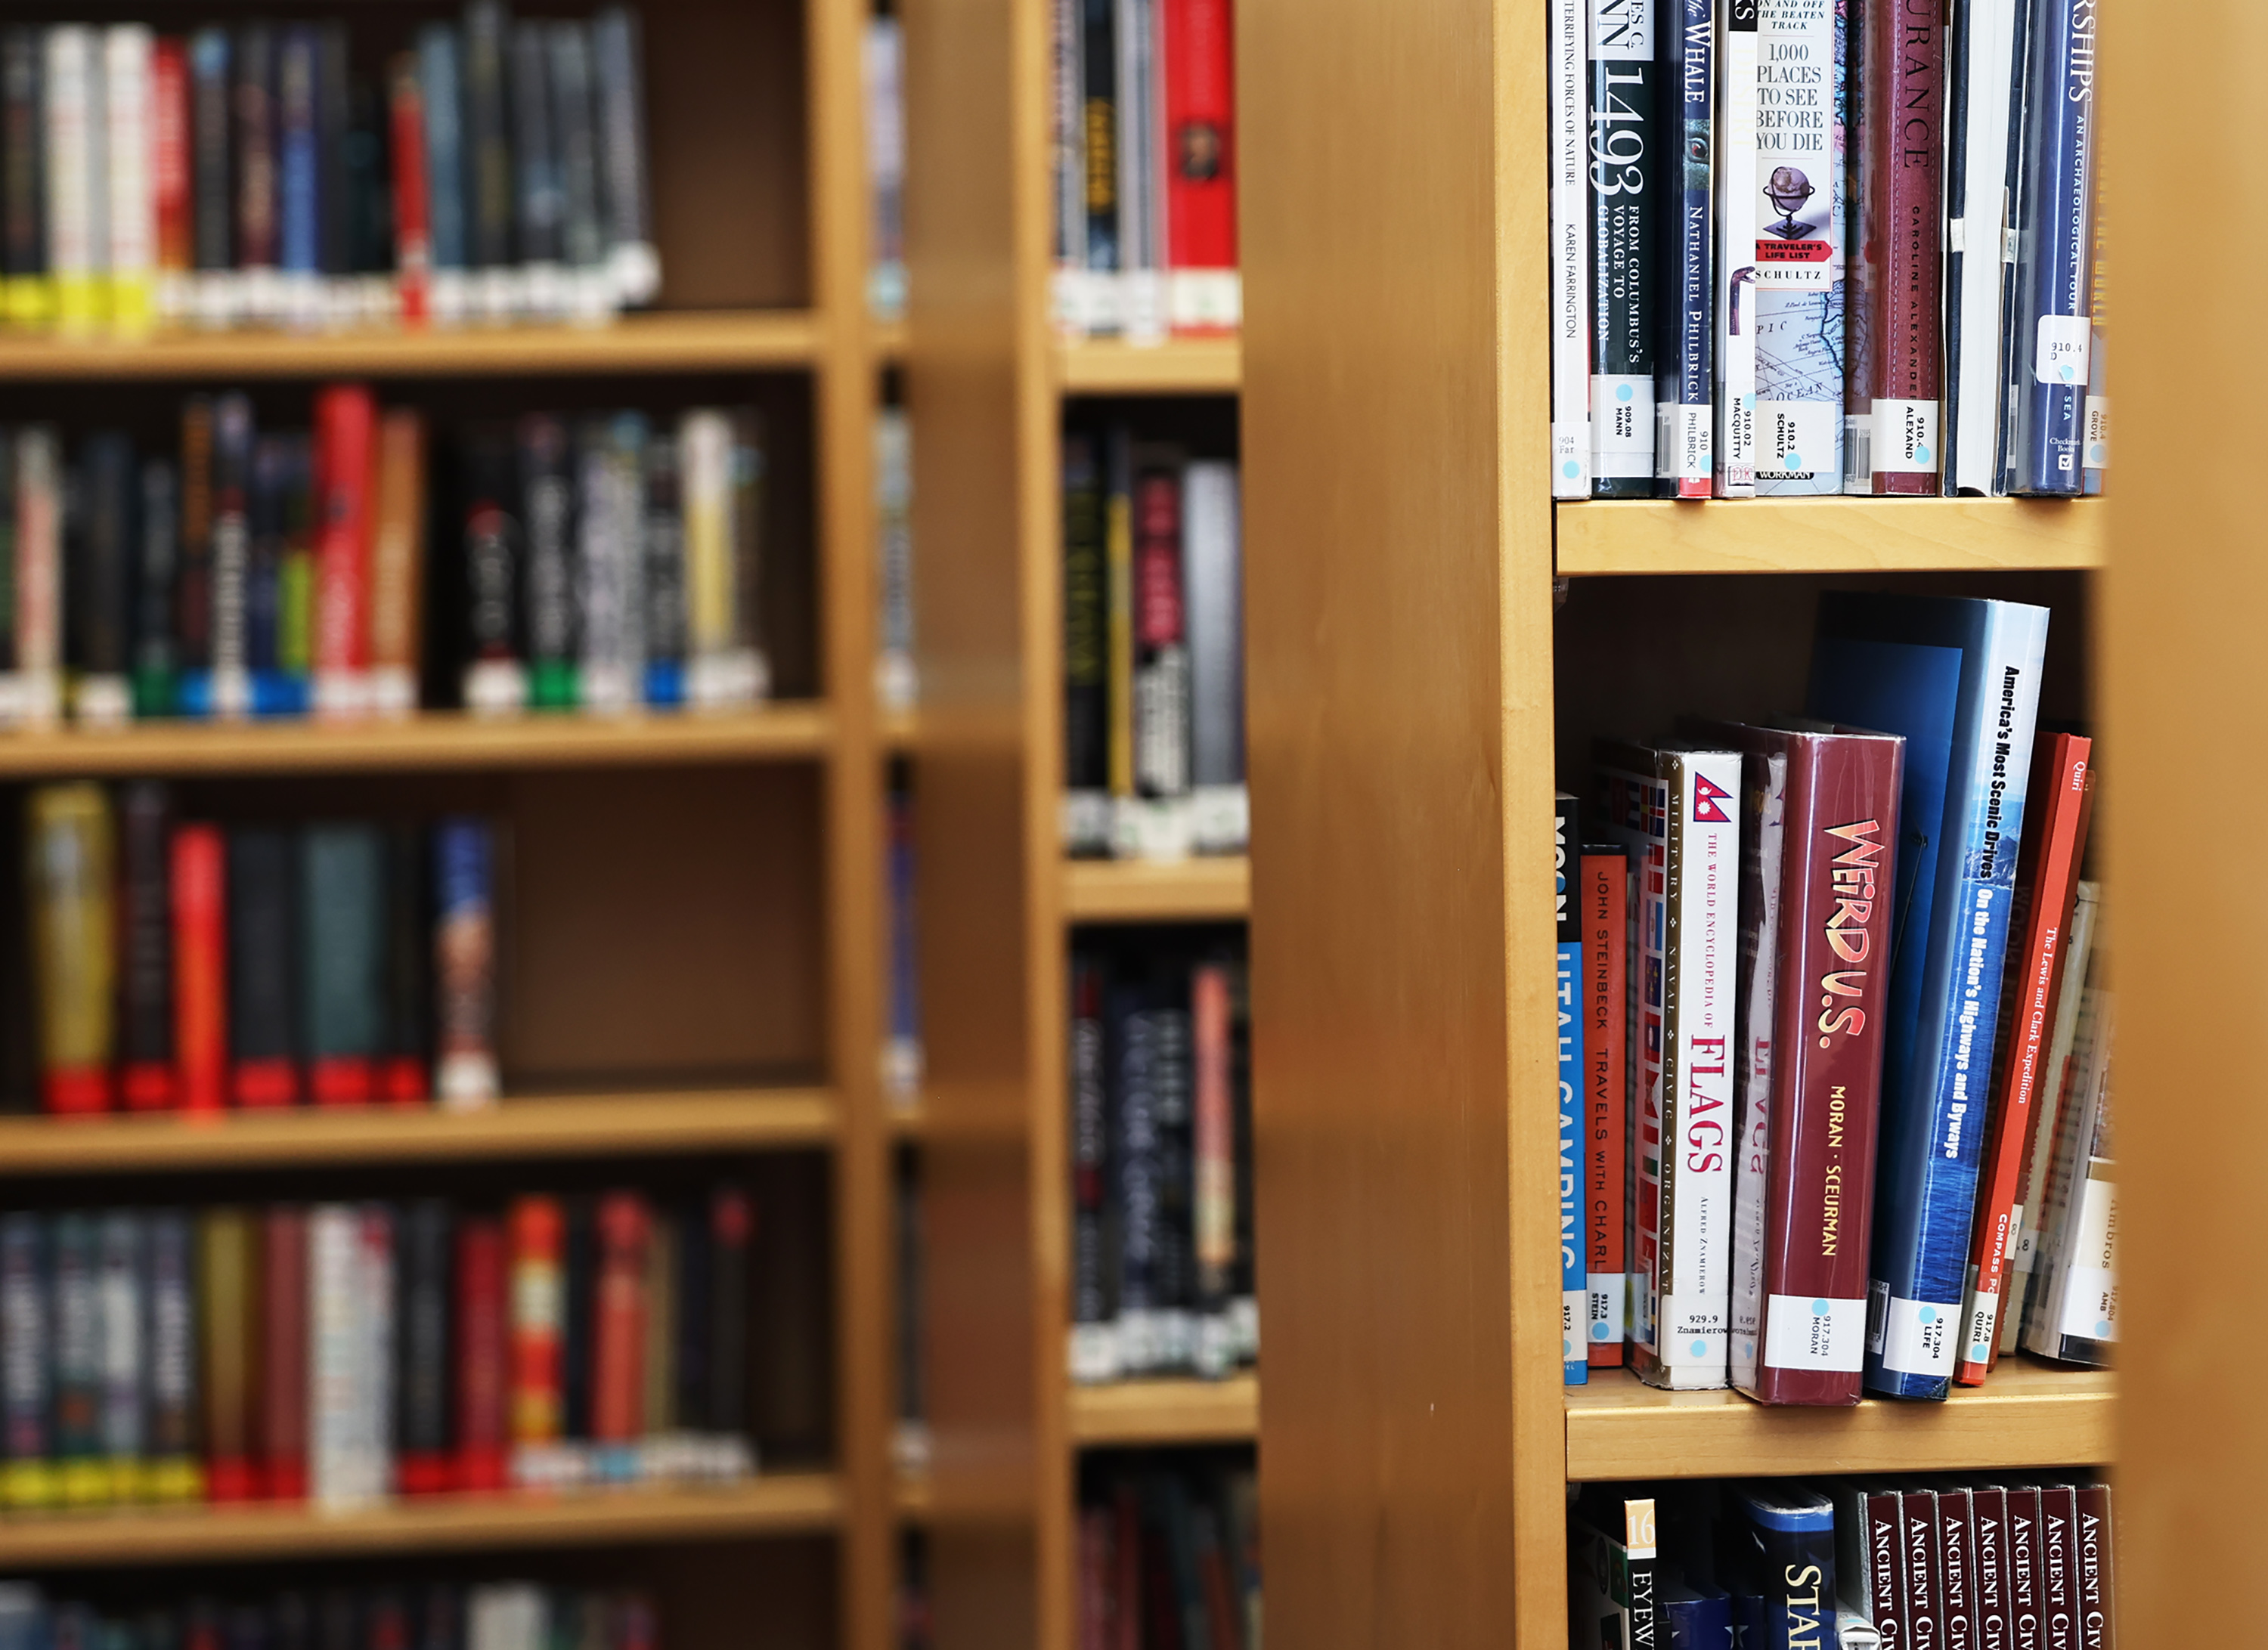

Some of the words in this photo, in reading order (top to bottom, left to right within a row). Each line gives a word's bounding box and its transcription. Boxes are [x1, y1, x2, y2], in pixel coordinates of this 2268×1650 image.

[1774, 0, 1799, 8] AND
[1802, 0, 1825, 9] OFF
[1781, 11, 1826, 20] BEATEN
[1563, 2, 1576, 71] TERRIFYING
[1630, 31, 1644, 49] C.
[1771, 21, 1808, 30] TRACK
[1684, 20, 1712, 104] WHALE
[1768, 43, 1810, 63] 1,000
[2068, 0, 2096, 103] RSHIPS
[1564, 71, 1576, 118] FORCES
[1757, 66, 1823, 84] PLACES
[1903, 0, 1931, 169] URANCE
[1757, 87, 1781, 107] TO
[1785, 88, 1819, 107] SEE
[1564, 121, 1576, 135] OF
[1589, 67, 1644, 196] 1493
[1756, 110, 1824, 129] BEFORE
[2076, 115, 2085, 135] AN
[1756, 132, 1787, 150] YOU
[1792, 133, 1823, 151] DIE
[1565, 138, 1576, 187] NATURE
[2069, 138, 2084, 268] ARCHAEOLOGICAL
[1565, 224, 1577, 262] KAREN
[1613, 205, 1625, 270] VOYAGE
[1628, 205, 1640, 251] FROM
[1764, 243, 1823, 251] TRAVELER'S
[1688, 206, 1704, 302] NATHANIEL
[1765, 251, 1786, 259] LIFE
[1911, 205, 1920, 293] CAROLINE
[1597, 204, 1610, 342] GLOBALIZATION
[1613, 275, 1625, 299] TO
[1755, 269, 1823, 280] SCHULTZ
[2068, 272, 2079, 310] TOUR
[1565, 265, 1577, 339] FARRINGTON
[1628, 258, 1644, 364] COLUMBUS'S
[1687, 310, 1703, 402] PHILBRICK
[2050, 342, 2083, 353] 910.4
[2050, 352, 2058, 361] D
[1624, 405, 1632, 438] 909.08
[2063, 395, 2072, 421] SEA
[2090, 410, 2099, 442] GROVE
[1558, 436, 1575, 445] 904
[1687, 412, 1697, 469] PHILBRICK
[1699, 431, 1709, 451] 910
[1730, 397, 1742, 460] MACQUITTY
[1743, 410, 1752, 447] 910.02
[1776, 412, 1786, 460] SCHULTZ
[1787, 421, 1796, 451] 910.2
[1904, 405, 1914, 460] ALEXAND
[1558, 445, 1575, 454] Far
[1759, 471, 1811, 479] WORKMAN
[1997, 664, 2020, 740] America's
[1992, 741, 2011, 779] Most
[2071, 760, 2087, 791] Quiri
[1986, 780, 2006, 829] Scenic
[1669, 793, 1680, 902] MILITARY
[1707, 832, 1718, 858] THE
[1980, 831, 2000, 879] Drives
[1596, 871, 1609, 921] JOHN
[1706, 862, 1718, 908] WORLD
[1975, 888, 1994, 909] On
[1972, 910, 1991, 936] the
[2043, 927, 2059, 950] The
[1596, 929, 1609, 1029] STEINBECK
[1704, 912, 1717, 1008] ENCYCLOPEDIA
[1964, 937, 1988, 998] Nation's
[2038, 952, 2054, 986] Lewis
[1666, 946, 1677, 1014] NAVAL
[2034, 986, 2045, 1009] and
[1704, 1012, 1714, 1029] OF
[1817, 970, 1867, 1049] U.S.
[2028, 1011, 2044, 1042] Clark
[1954, 1000, 1980, 1071] Highways
[1665, 1057, 1674, 1119] CIVIC
[1952, 1073, 1969, 1101] and
[2018, 1045, 2038, 1104] Expedition
[1594, 1048, 1609, 1141] TRAVELS
[1687, 1033, 1726, 1174] FLAGS
[1827, 1085, 1847, 1147] MORAN
[1944, 1102, 1967, 1159] Byways
[1594, 1150, 1606, 1190] WITH
[1699, 1196, 1709, 1234] ALFRED
[1821, 1164, 1842, 1256] SCEURMAN
[1594, 1200, 1608, 1271] CHARL
[1990, 1213, 2008, 1274] COMPASS
[1563, 1305, 1572, 1331] 917.2
[1591, 1292, 1600, 1321] STEIN
[1600, 1293, 1609, 1320] 917.3
[1689, 1314, 1719, 1323] 929.9
[2099, 1291, 2109, 1312] AMB
[1810, 1317, 1820, 1355] MORAN
[1821, 1315, 1832, 1357] 917.304
[1923, 1326, 1932, 1349] LIFE
[1932, 1317, 1944, 1359] 917.304
[1972, 1311, 1985, 1343] QUIRI
[1983, 1314, 1994, 1342] 917.8
[1628, 1509, 1656, 1546] 16
[1875, 1518, 1893, 1611] ANCIENT
[1910, 1516, 1929, 1610] ANCIENT
[1945, 1515, 1964, 1608] ANCIENT
[1980, 1515, 1999, 1608] ANCIENT
[2013, 1514, 2032, 1607] ANCIENT
[2046, 1513, 2065, 1606] ANCIENT
[2081, 1512, 2101, 1605] ANCIENT
[2086, 1611, 2105, 1650] CIV
